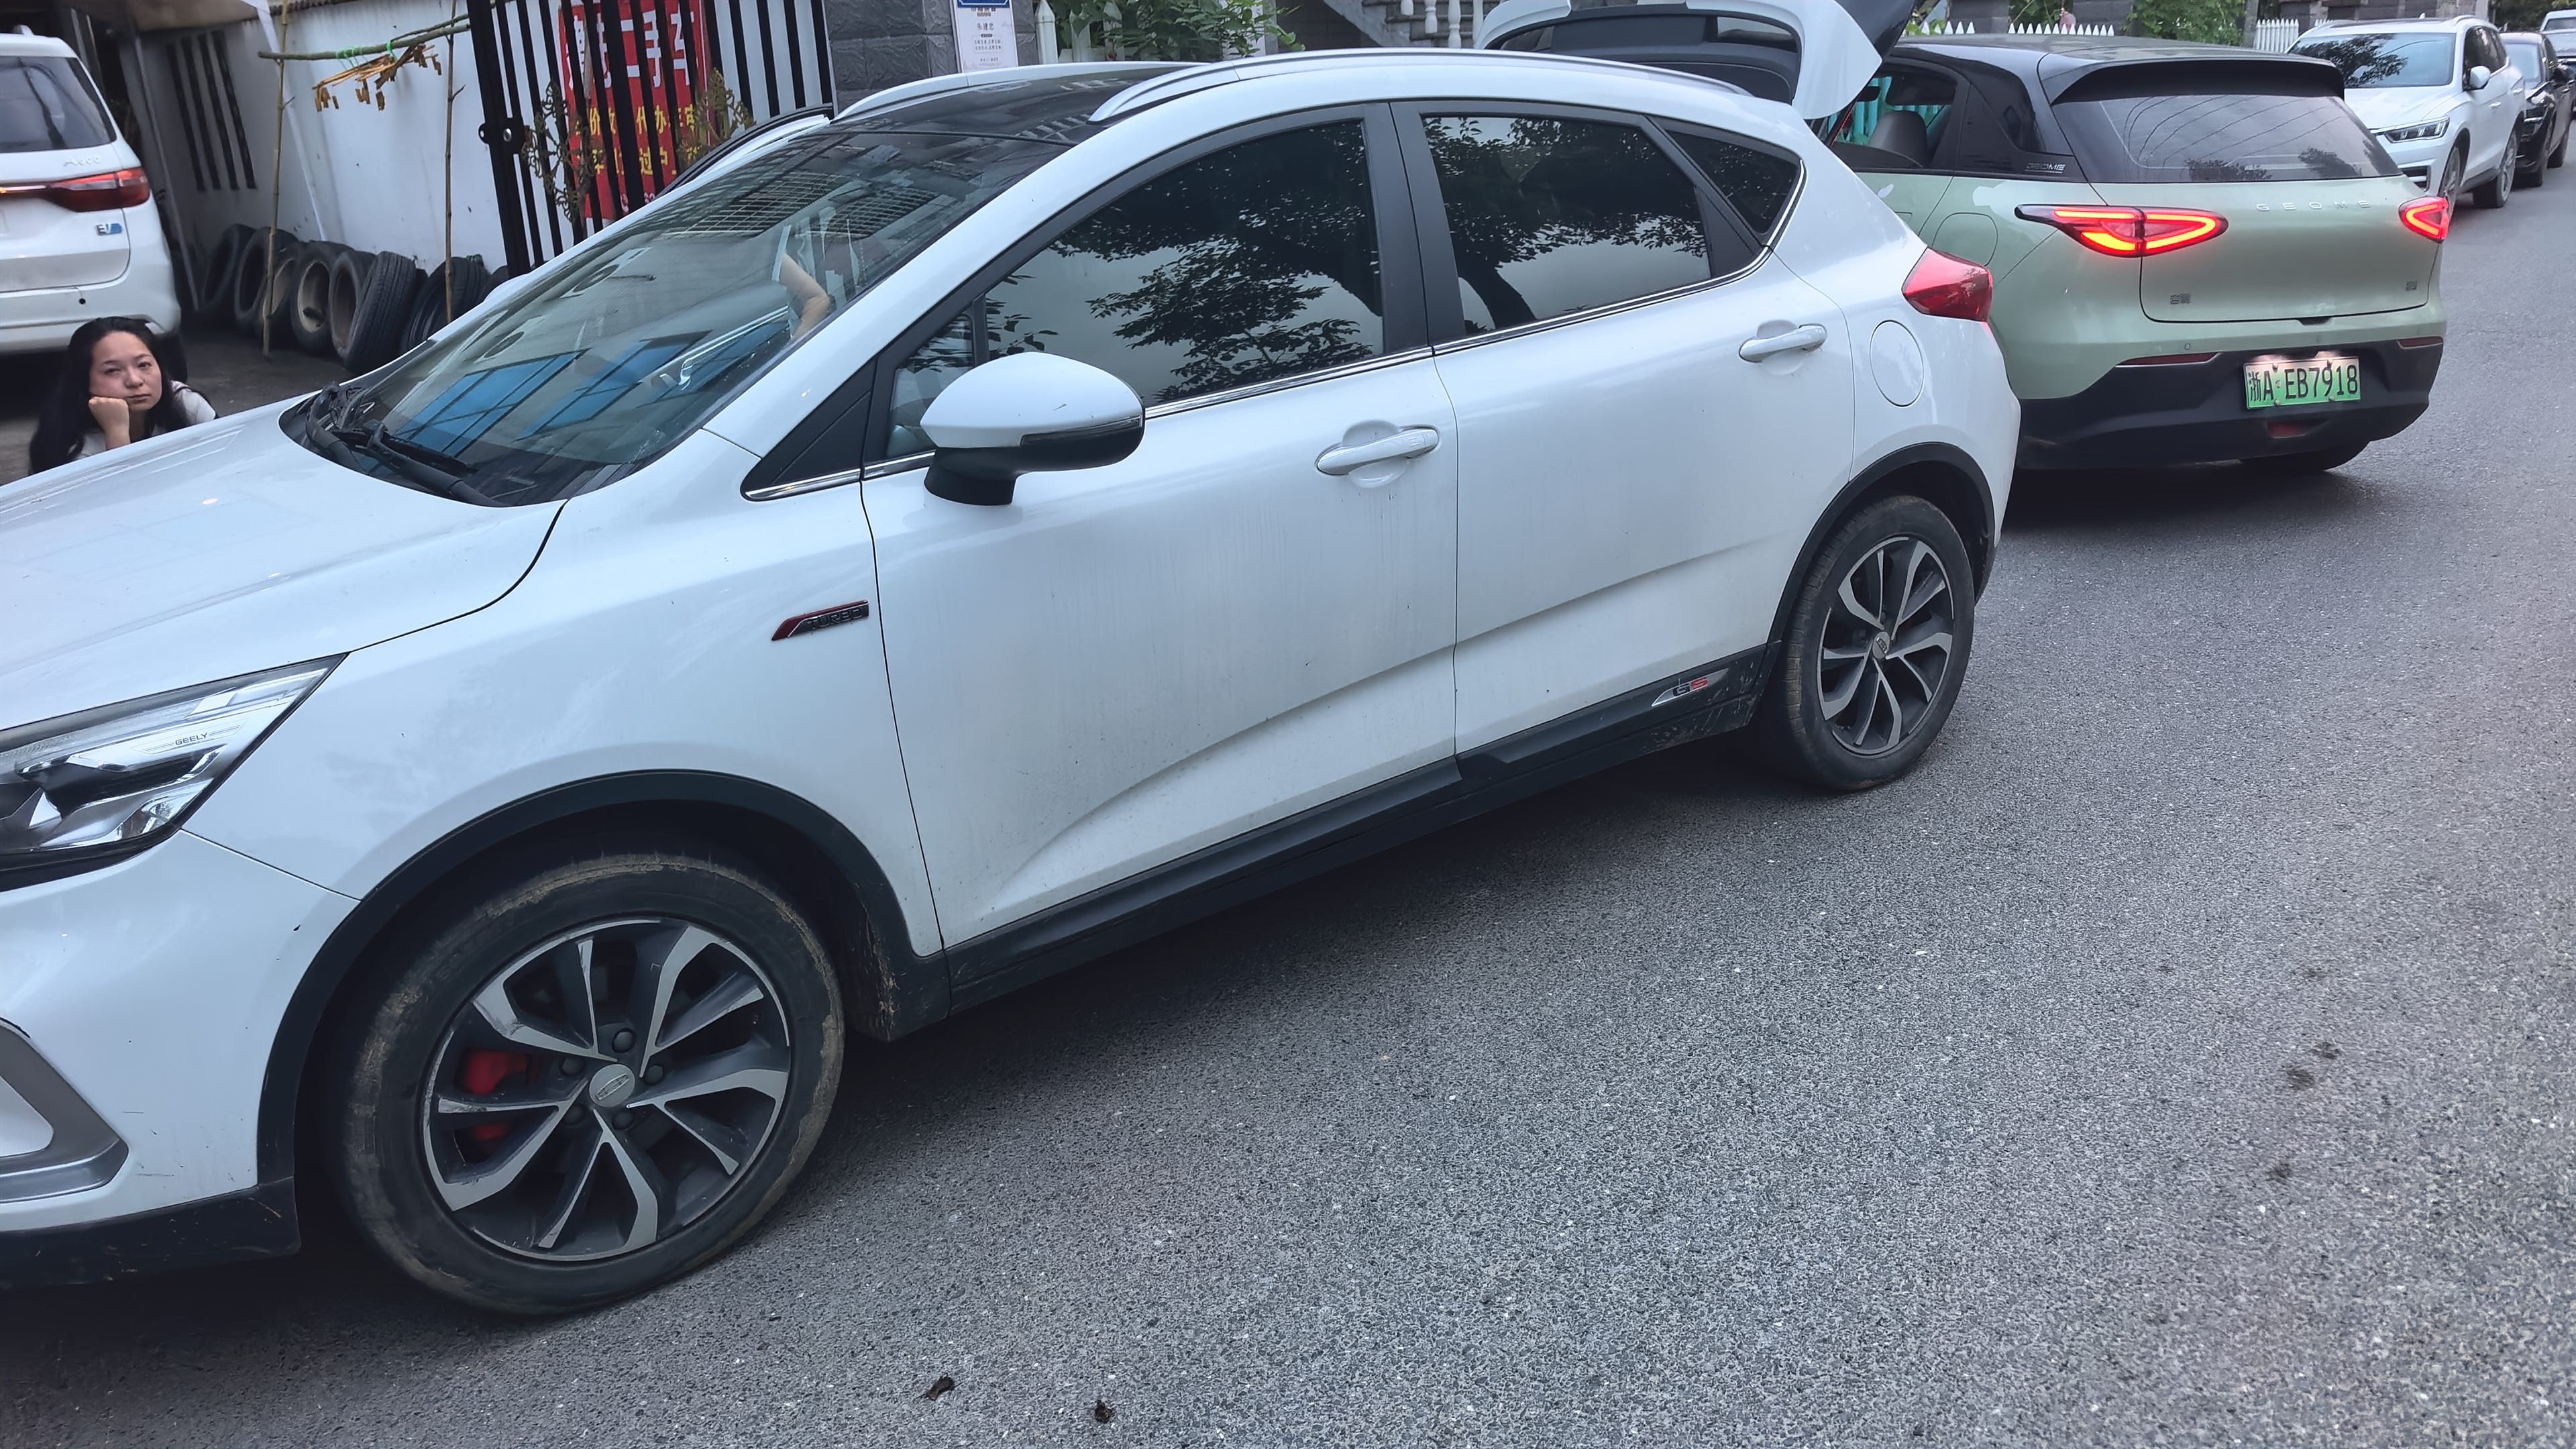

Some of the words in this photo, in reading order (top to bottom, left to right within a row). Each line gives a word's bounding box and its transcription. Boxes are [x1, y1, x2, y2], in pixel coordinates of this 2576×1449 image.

[2256, 201, 2371, 211] GEOME
[2248, 370, 2274, 402] 浙A
[2284, 364, 2358, 399] EB7918
[807, 607, 863, 630] TURBO
[175, 732, 208, 745] GEELY
